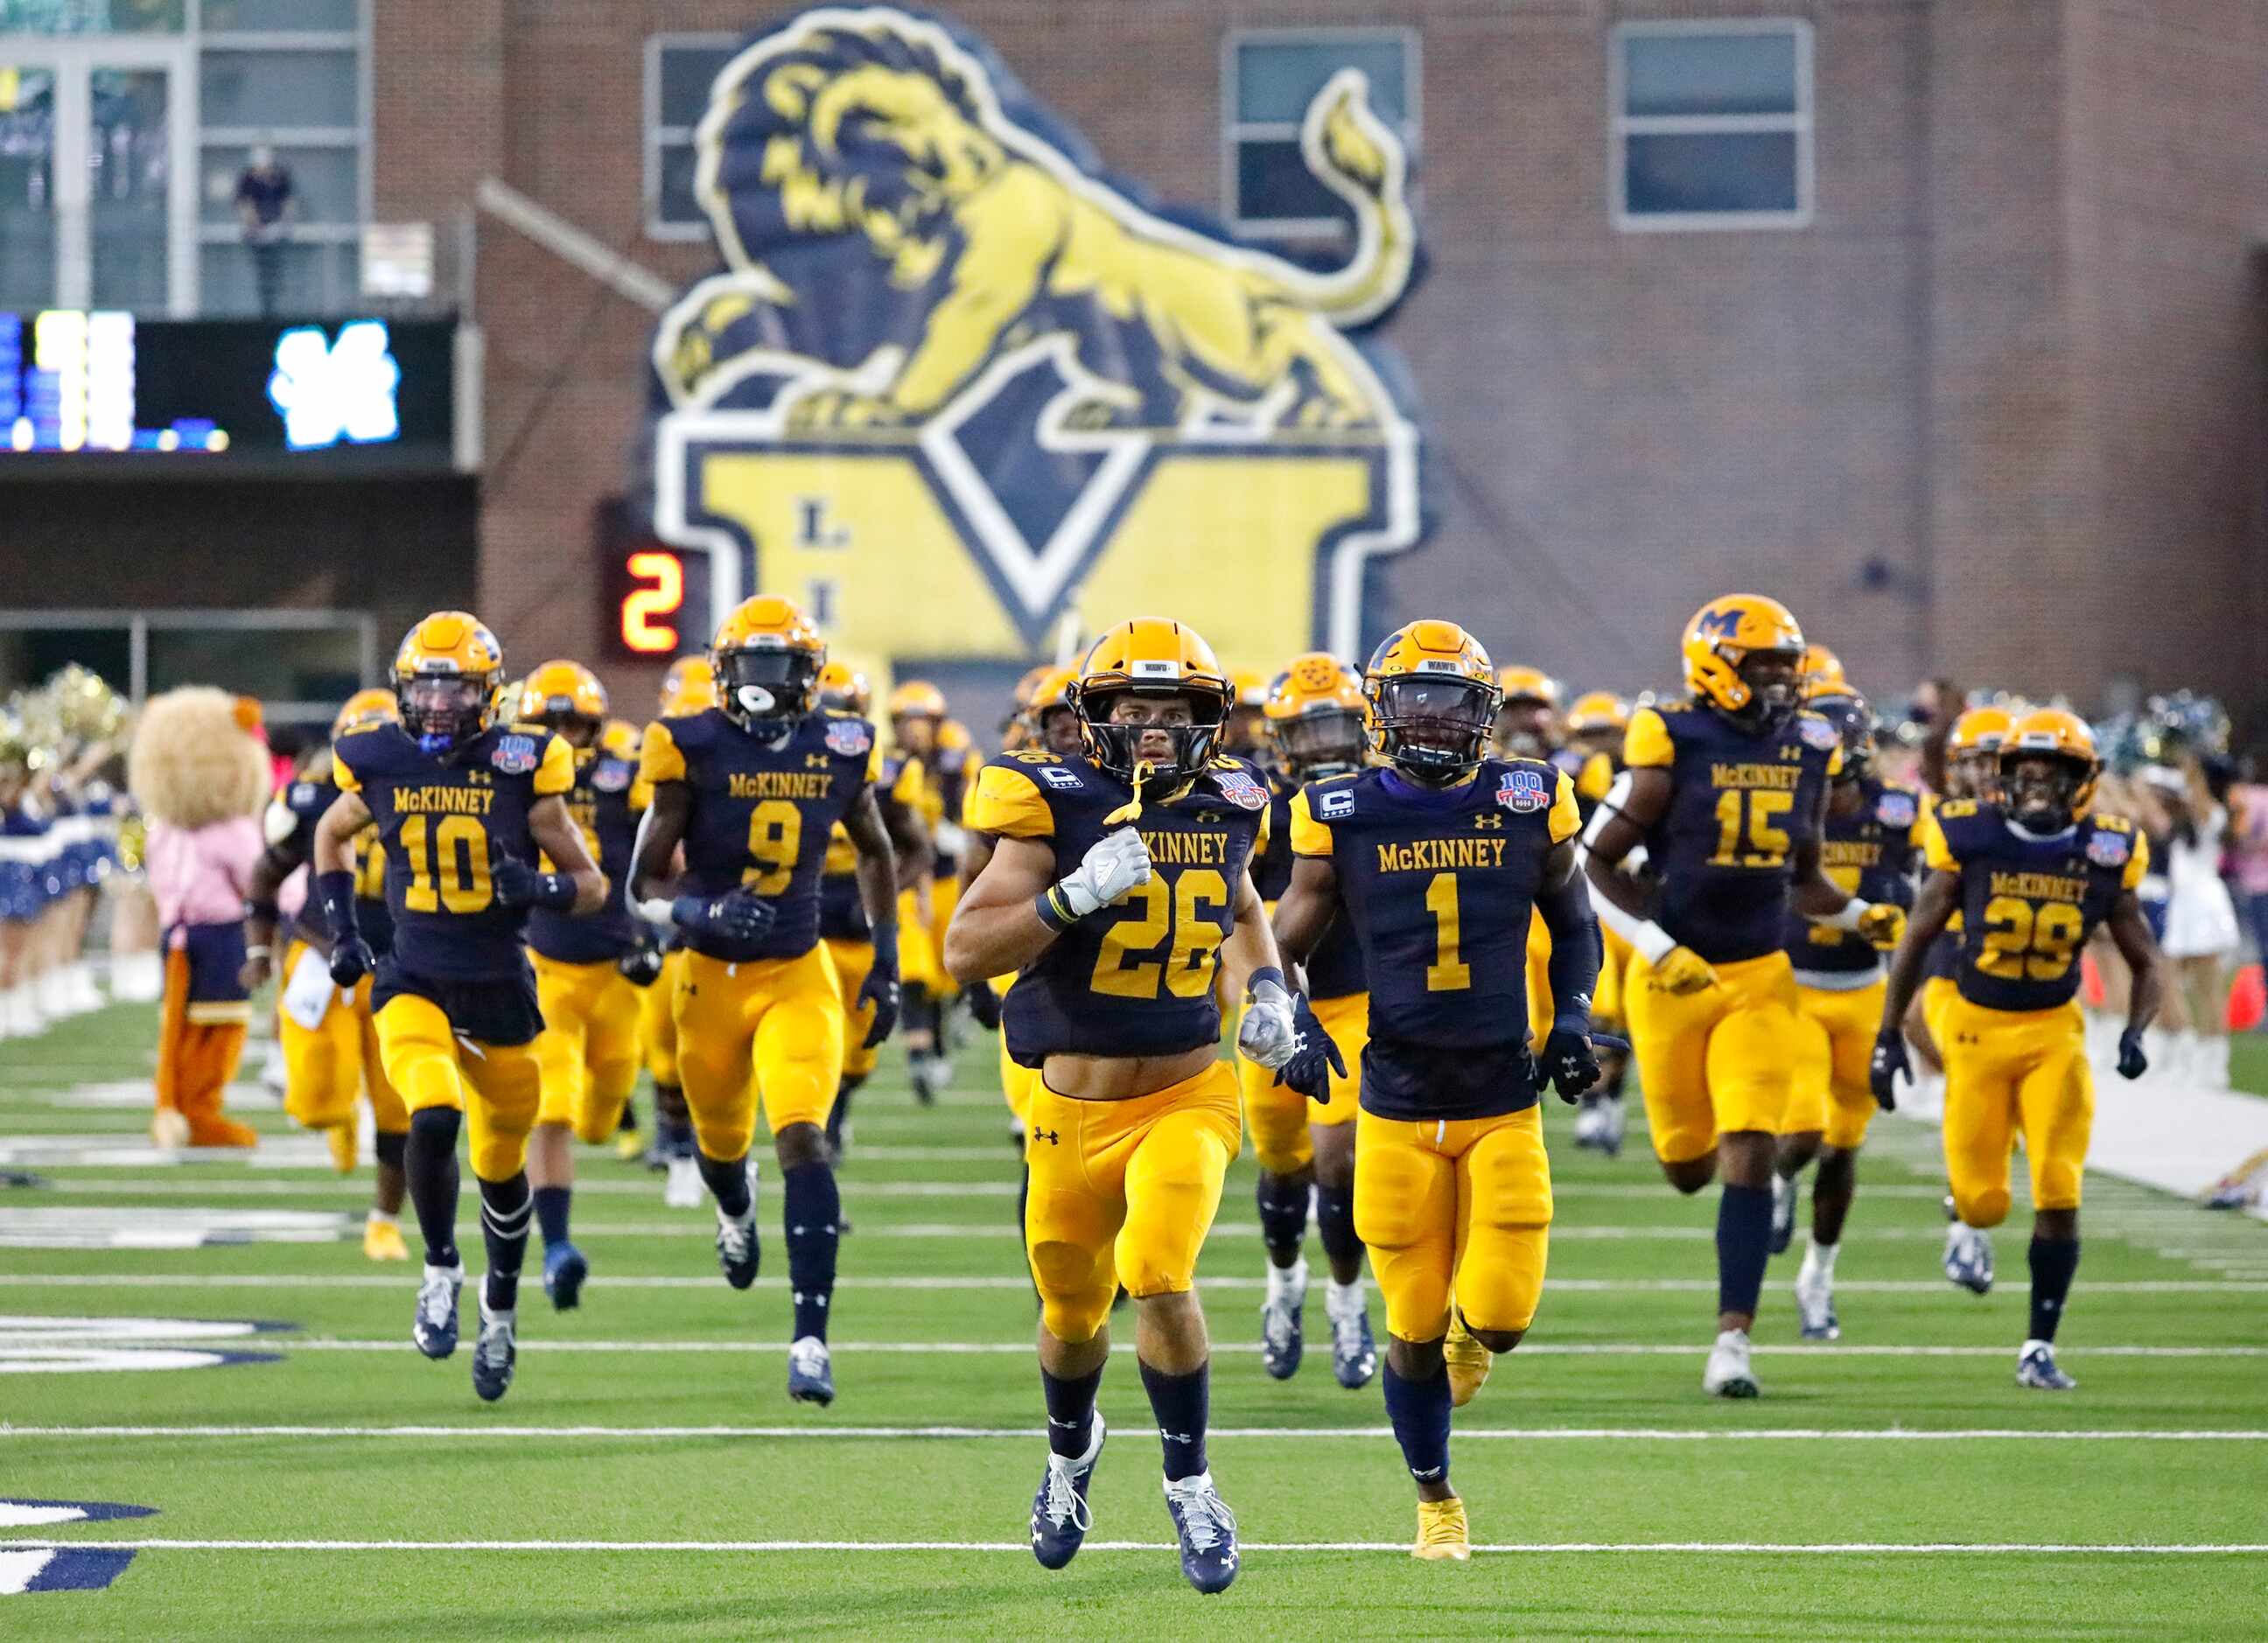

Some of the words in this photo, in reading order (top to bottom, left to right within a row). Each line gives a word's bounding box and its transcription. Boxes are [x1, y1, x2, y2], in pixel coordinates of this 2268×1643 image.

[622, 552, 683, 651] 2
[393, 786, 496, 815] McKINNEY
[729, 772, 834, 800] McKINNEY
[1212, 772, 1259, 790] 100
[1322, 790, 1352, 812] C
[1500, 770, 1544, 791] 100
[741, 800, 802, 897] 9
[1140, 832, 1228, 863] KINNEY
[1376, 838, 1508, 873] McKINNEY
[1705, 788, 1795, 868] 15
[399, 814, 494, 914] 10
[1090, 868, 1228, 999] 26
[1424, 871, 1472, 992] 1
[1974, 896, 2082, 981] 29
